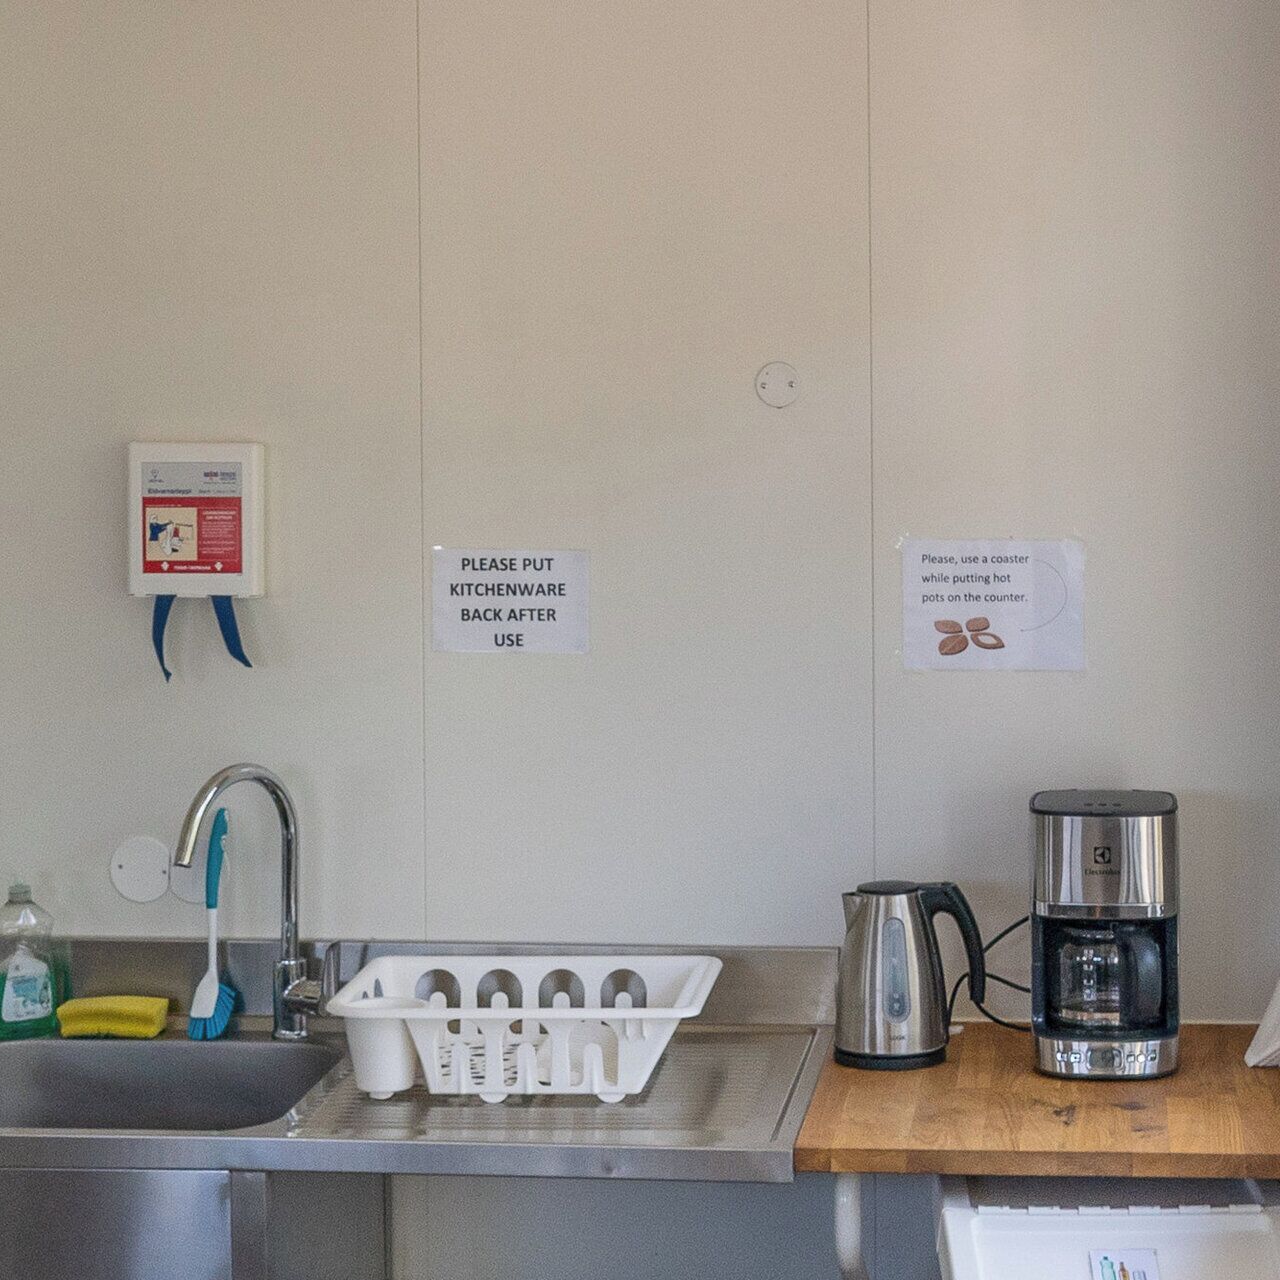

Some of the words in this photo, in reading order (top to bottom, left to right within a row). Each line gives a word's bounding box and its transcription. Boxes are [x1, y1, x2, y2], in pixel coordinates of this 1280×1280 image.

[461, 558, 517, 571] PLEASE
[522, 558, 554, 571] PUT
[921, 554, 958, 565] Please,
[961, 556, 979, 564] use
[982, 556, 988, 564] a
[990, 555, 1029, 564] coaster
[921, 573, 950, 583] while
[952, 573, 991, 586] putting
[993, 573, 1011, 583] hot
[450, 583, 567, 596] KITCHENWARE
[922, 594, 945, 604] pots
[964, 593, 982, 602] the
[984, 594, 1028, 602] counter.
[461, 608, 503, 622] BACK
[507, 608, 557, 622] AFTER
[494, 633, 524, 647] USE
